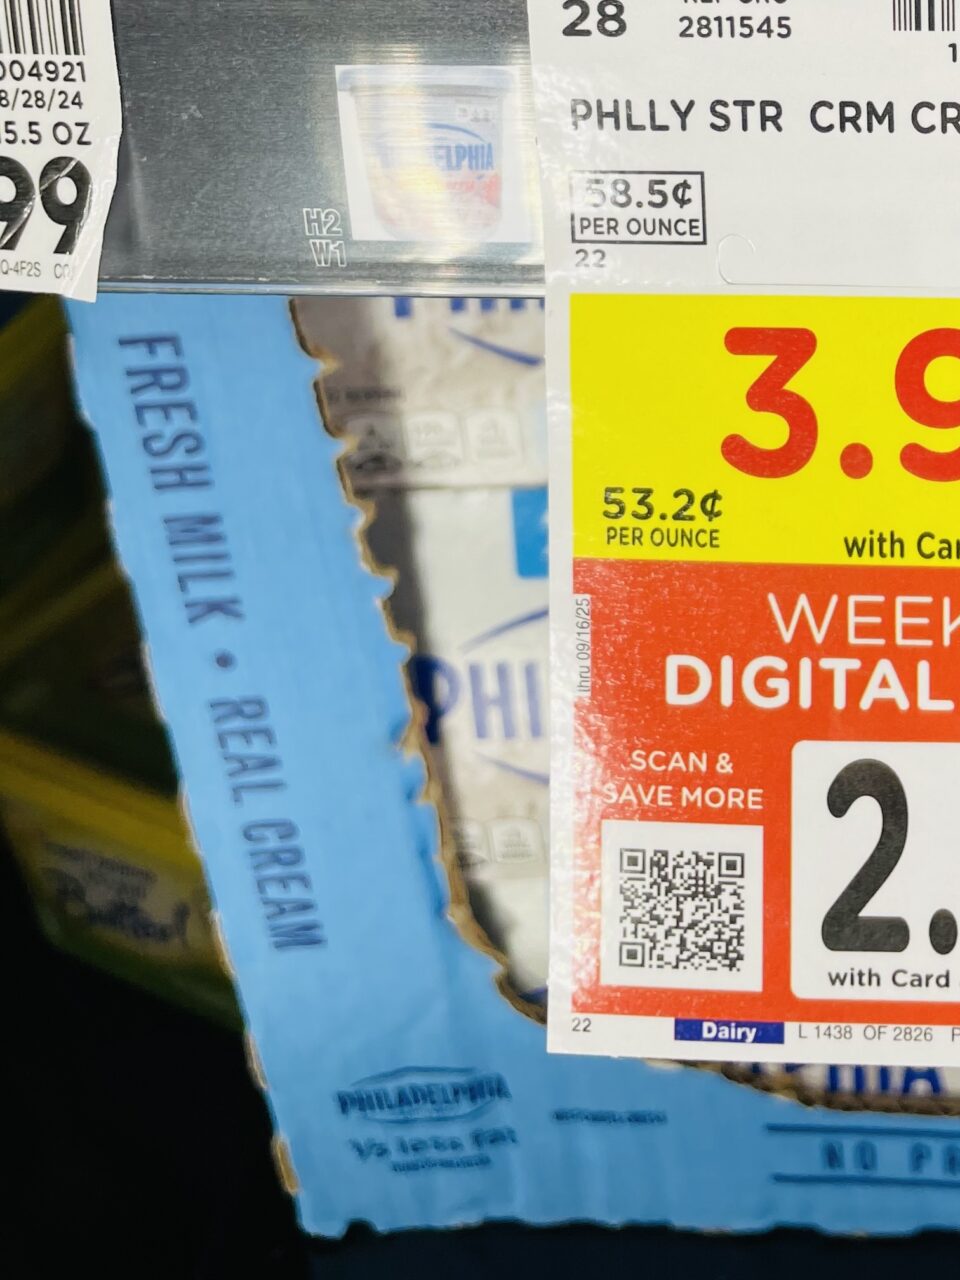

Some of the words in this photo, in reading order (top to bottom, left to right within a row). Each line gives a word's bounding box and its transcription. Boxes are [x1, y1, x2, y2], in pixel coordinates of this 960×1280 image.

[679, 16, 792, 39] 2811545
[570, 98, 696, 132] PHLLY
[709, 99, 783, 132] STR
[809, 100, 895, 133] CRM
[52, 122, 92, 145] OZ
[585, 179, 693, 209] 58.5¢
[303, 208, 342, 236] H2
[579, 218, 619, 235] PER
[627, 218, 701, 236] OUNCE
[309, 239, 347, 267] W1
[574, 249, 607, 269] 22
[118, 333, 213, 492] FRESH
[602, 487, 723, 521] 53.2¢
[607, 527, 643, 546] PER
[650, 528, 720, 548] OUNCE
[844, 532, 910, 560] with
[162, 513, 243, 625] MILK
[575, 598, 591, 662] 09/16/25
[665, 655, 952, 711] DIGITAL
[208, 695, 287, 807] REAL
[630, 750, 707, 773] SCAN
[716, 753, 733, 773] &
[602, 783, 673, 807] SAVE
[682, 787, 763, 809] MORE
[242, 819, 327, 954] CREAM
[828, 968, 881, 987] with
[892, 969, 950, 989] Card
[572, 1018, 592, 1033] 22
[702, 1021, 757, 1044] Dairy
[815, 1024, 852, 1040] 1438
[863, 1026, 887, 1041] OF
[893, 1026, 933, 1042] 2826
